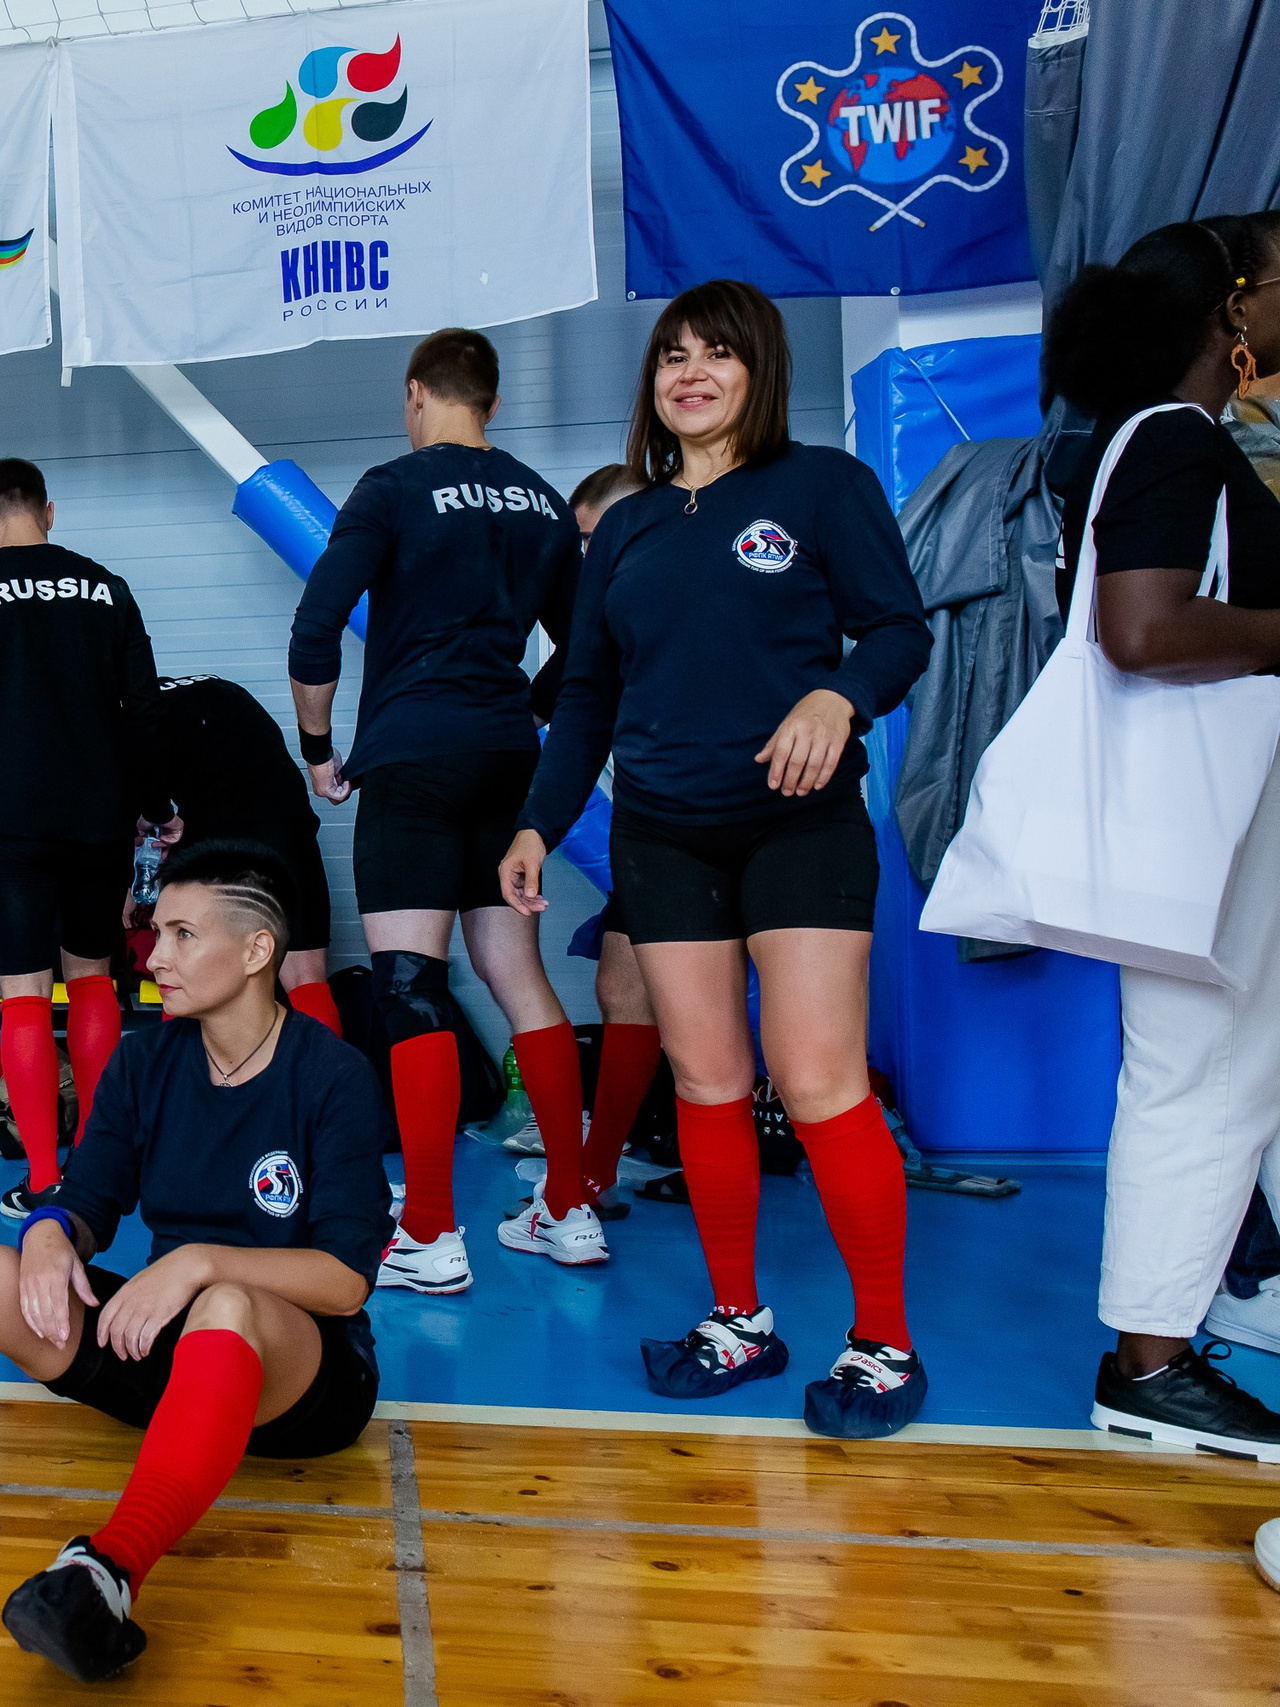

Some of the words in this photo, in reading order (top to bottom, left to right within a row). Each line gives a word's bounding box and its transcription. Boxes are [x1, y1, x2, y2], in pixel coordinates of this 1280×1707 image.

[839, 98, 941, 147] TWIF
[232, 190, 302, 215] КОМИТЕТ
[305, 180, 432, 201] НАЦИОНАЛЬНЫХ
[258, 211, 269, 224] И
[273, 198, 406, 222] НЕОЛИМПИЙСКИХ
[276, 213, 324, 236] ВИДОВ
[327, 214, 389, 227] СПОРТА
[280, 240, 389, 304] КННВС
[283, 297, 388, 321] РОССИИ
[432, 483, 559, 520] RUSSIA
[861, 1358, 883, 1374] asics
